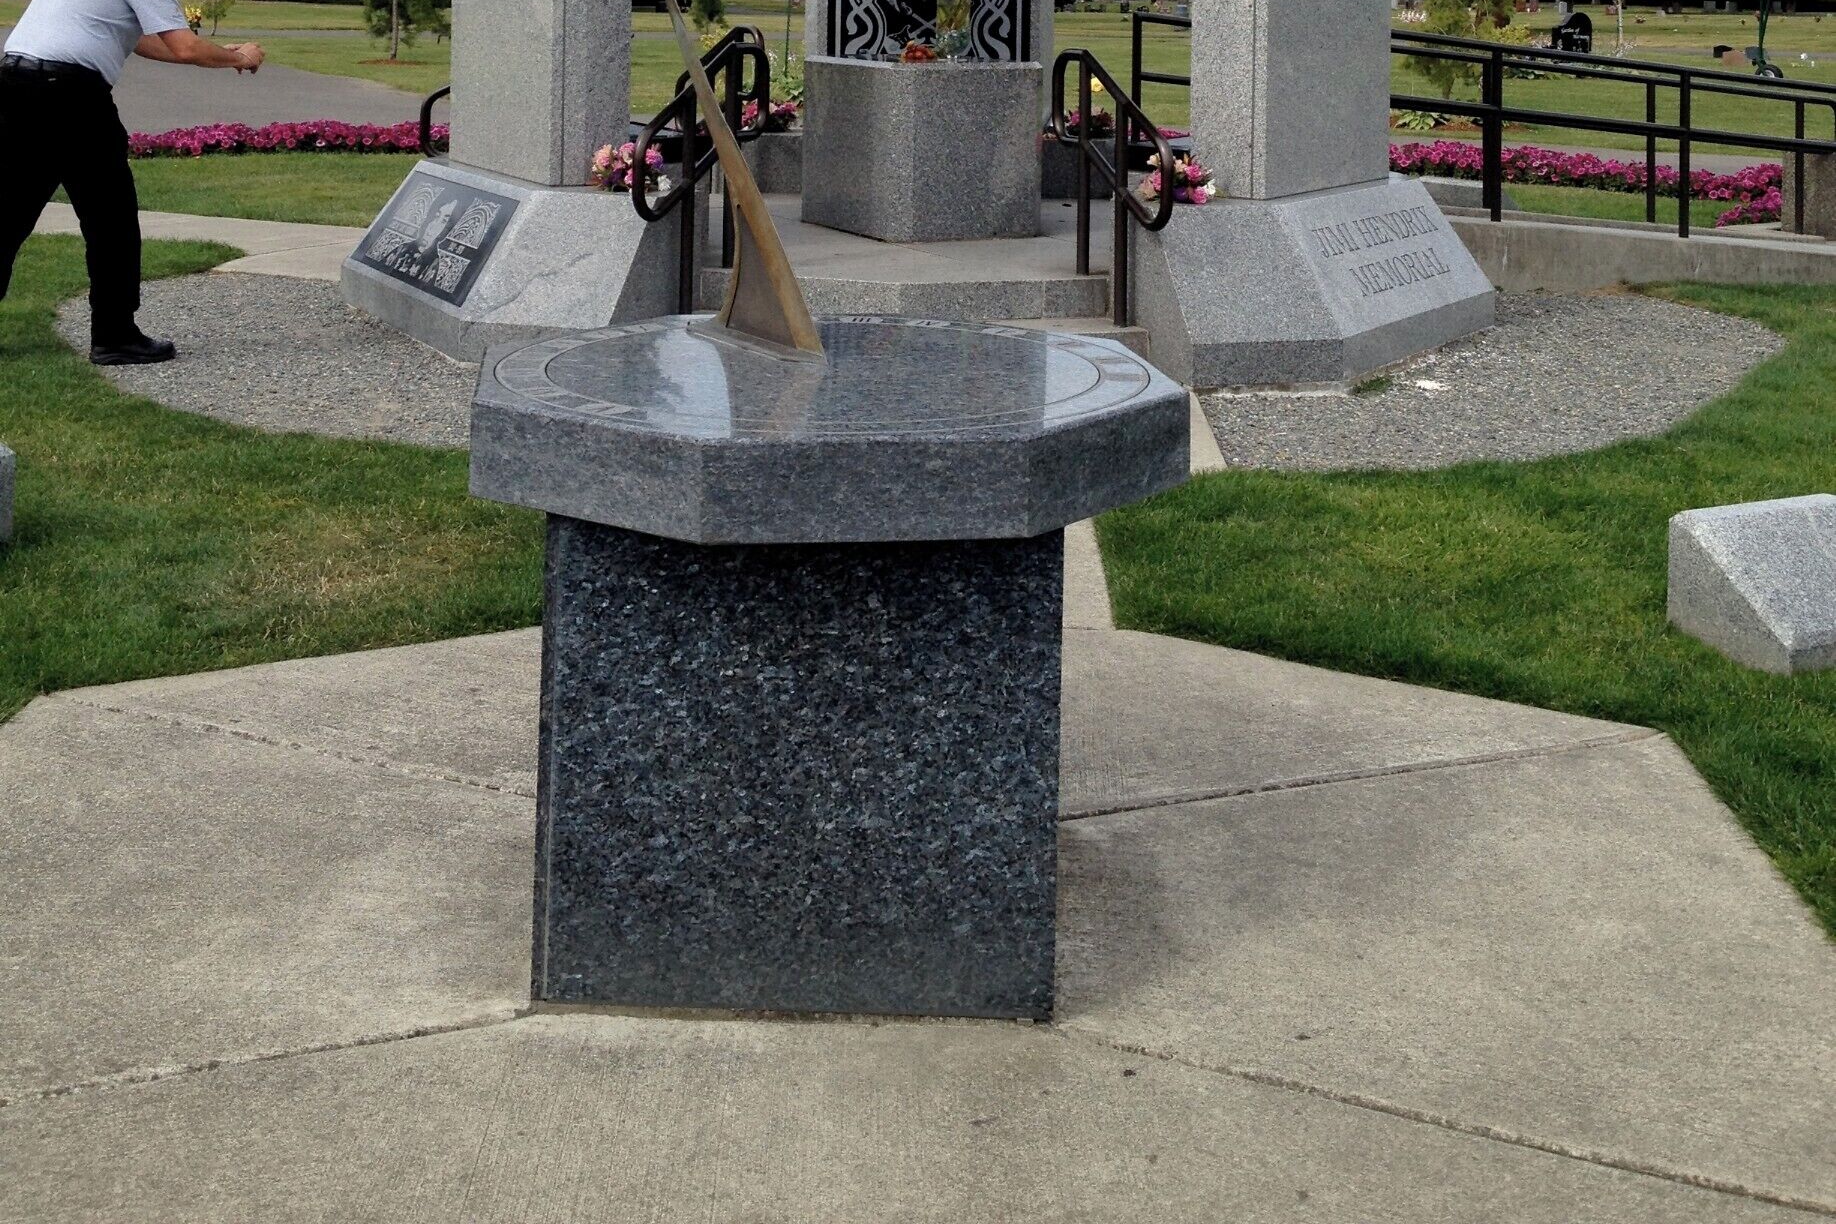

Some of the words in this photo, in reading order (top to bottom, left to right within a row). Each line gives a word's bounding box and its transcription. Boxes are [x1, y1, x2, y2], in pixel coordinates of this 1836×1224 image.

[1312, 222, 1360, 258] JIMI
[1352, 205, 1439, 248] HENDRIX
[1349, 247, 1451, 297] MEMORIAL
